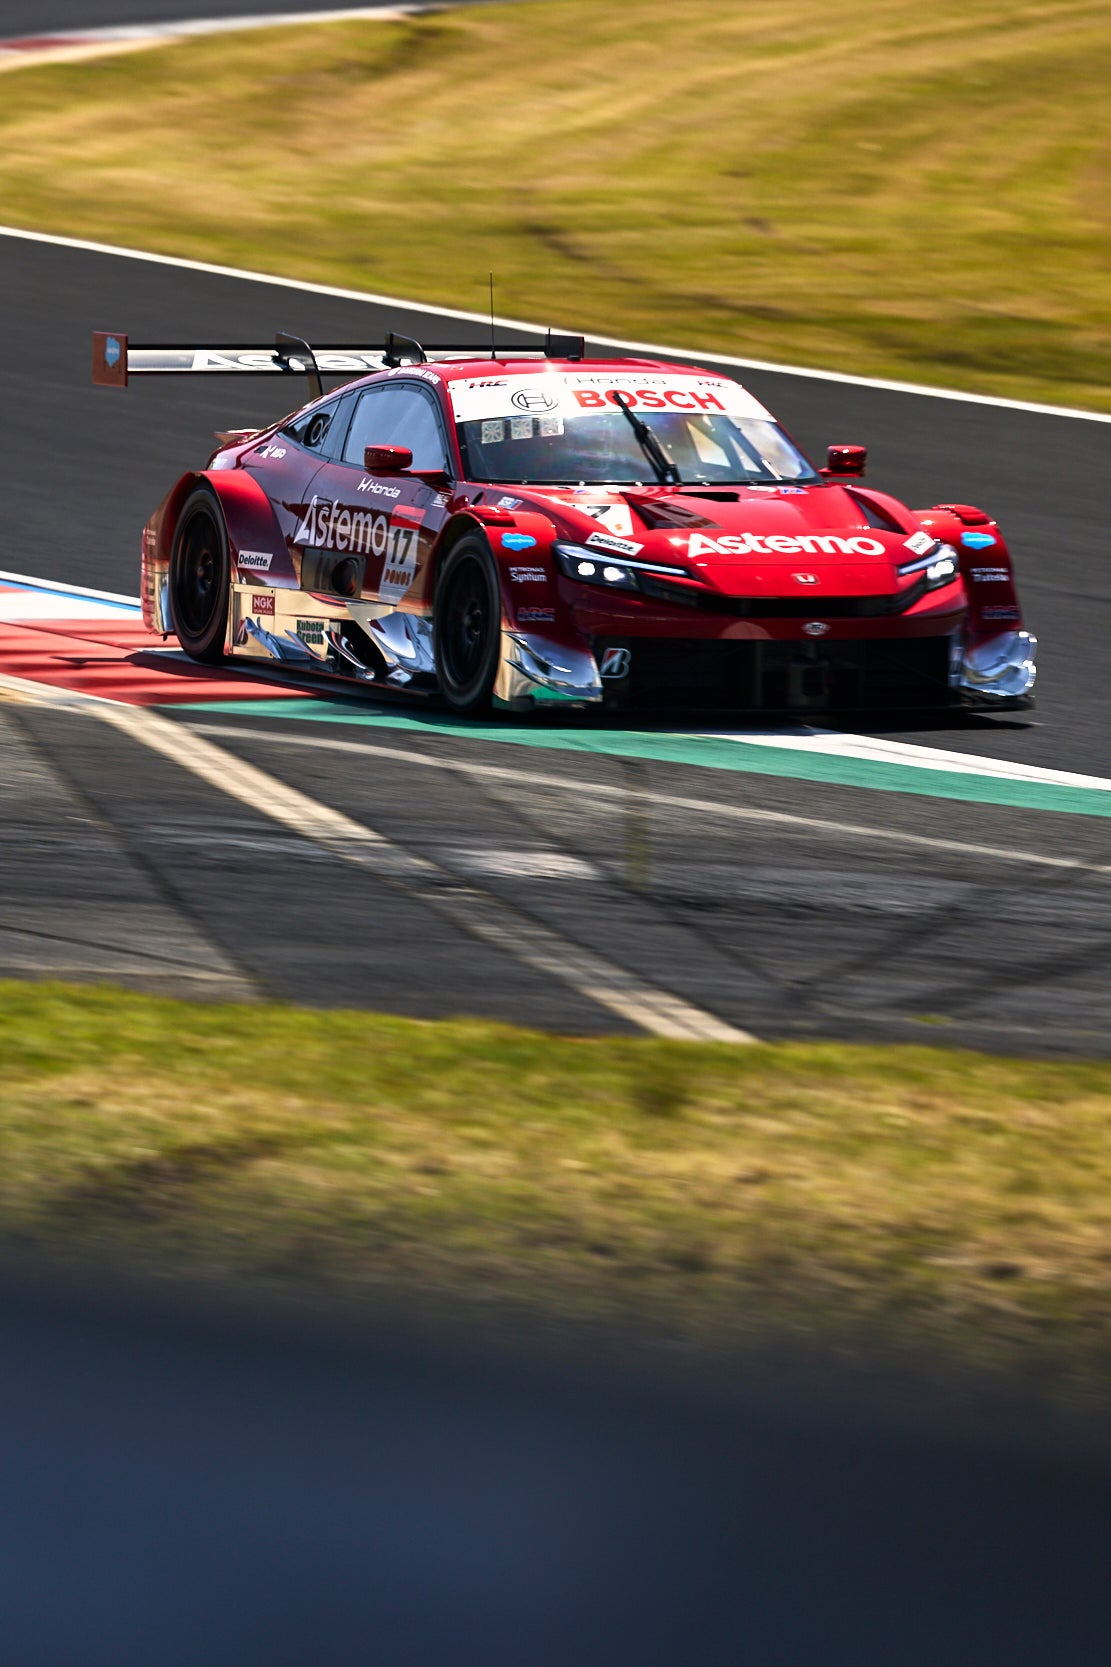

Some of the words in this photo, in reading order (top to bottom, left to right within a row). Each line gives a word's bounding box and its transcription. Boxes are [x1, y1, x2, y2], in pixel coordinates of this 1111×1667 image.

[571, 390, 727, 411] BOSCH
[367, 482, 401, 498] Honda
[293, 494, 388, 557] Astemo
[390, 529, 414, 565] 17
[687, 532, 886, 558] Astemo
[253, 596, 273, 609] NGK
